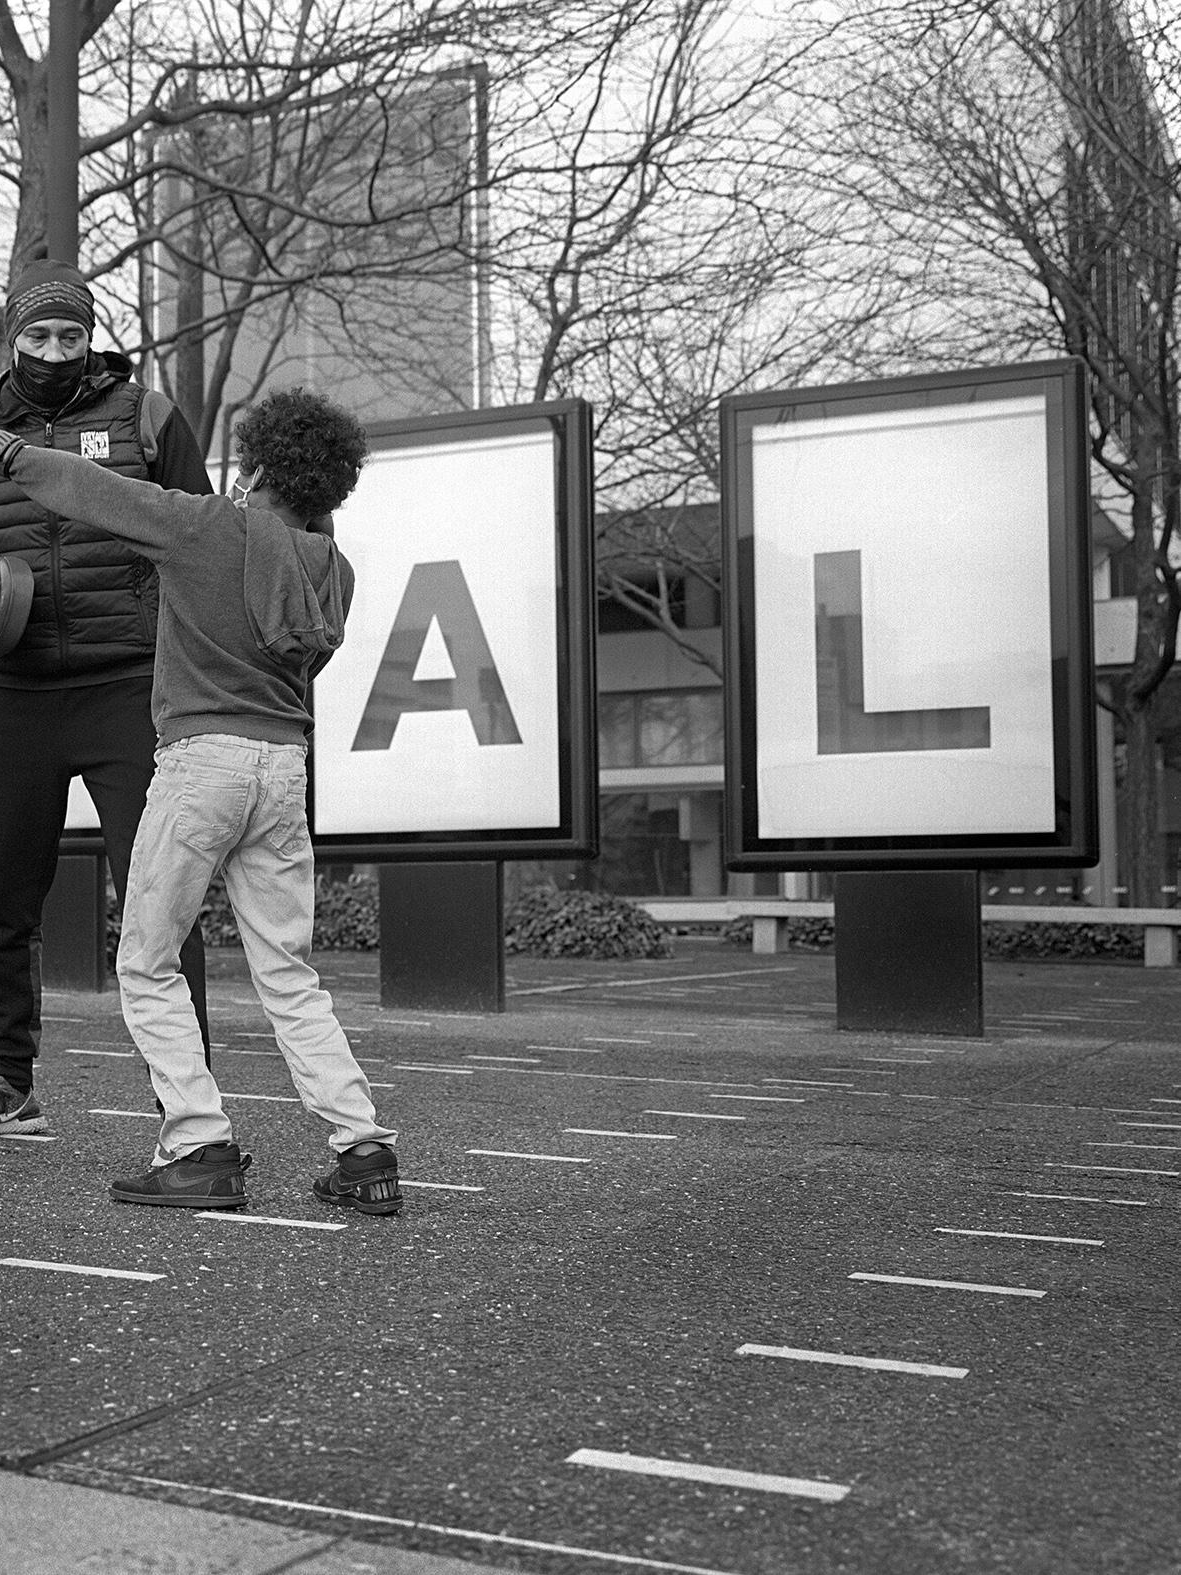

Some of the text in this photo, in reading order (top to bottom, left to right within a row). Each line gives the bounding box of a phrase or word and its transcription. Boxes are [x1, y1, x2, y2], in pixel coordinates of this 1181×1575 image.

[350, 559, 524, 752] A
[814, 549, 991, 756] L
[369, 1180, 399, 1200] NIK
